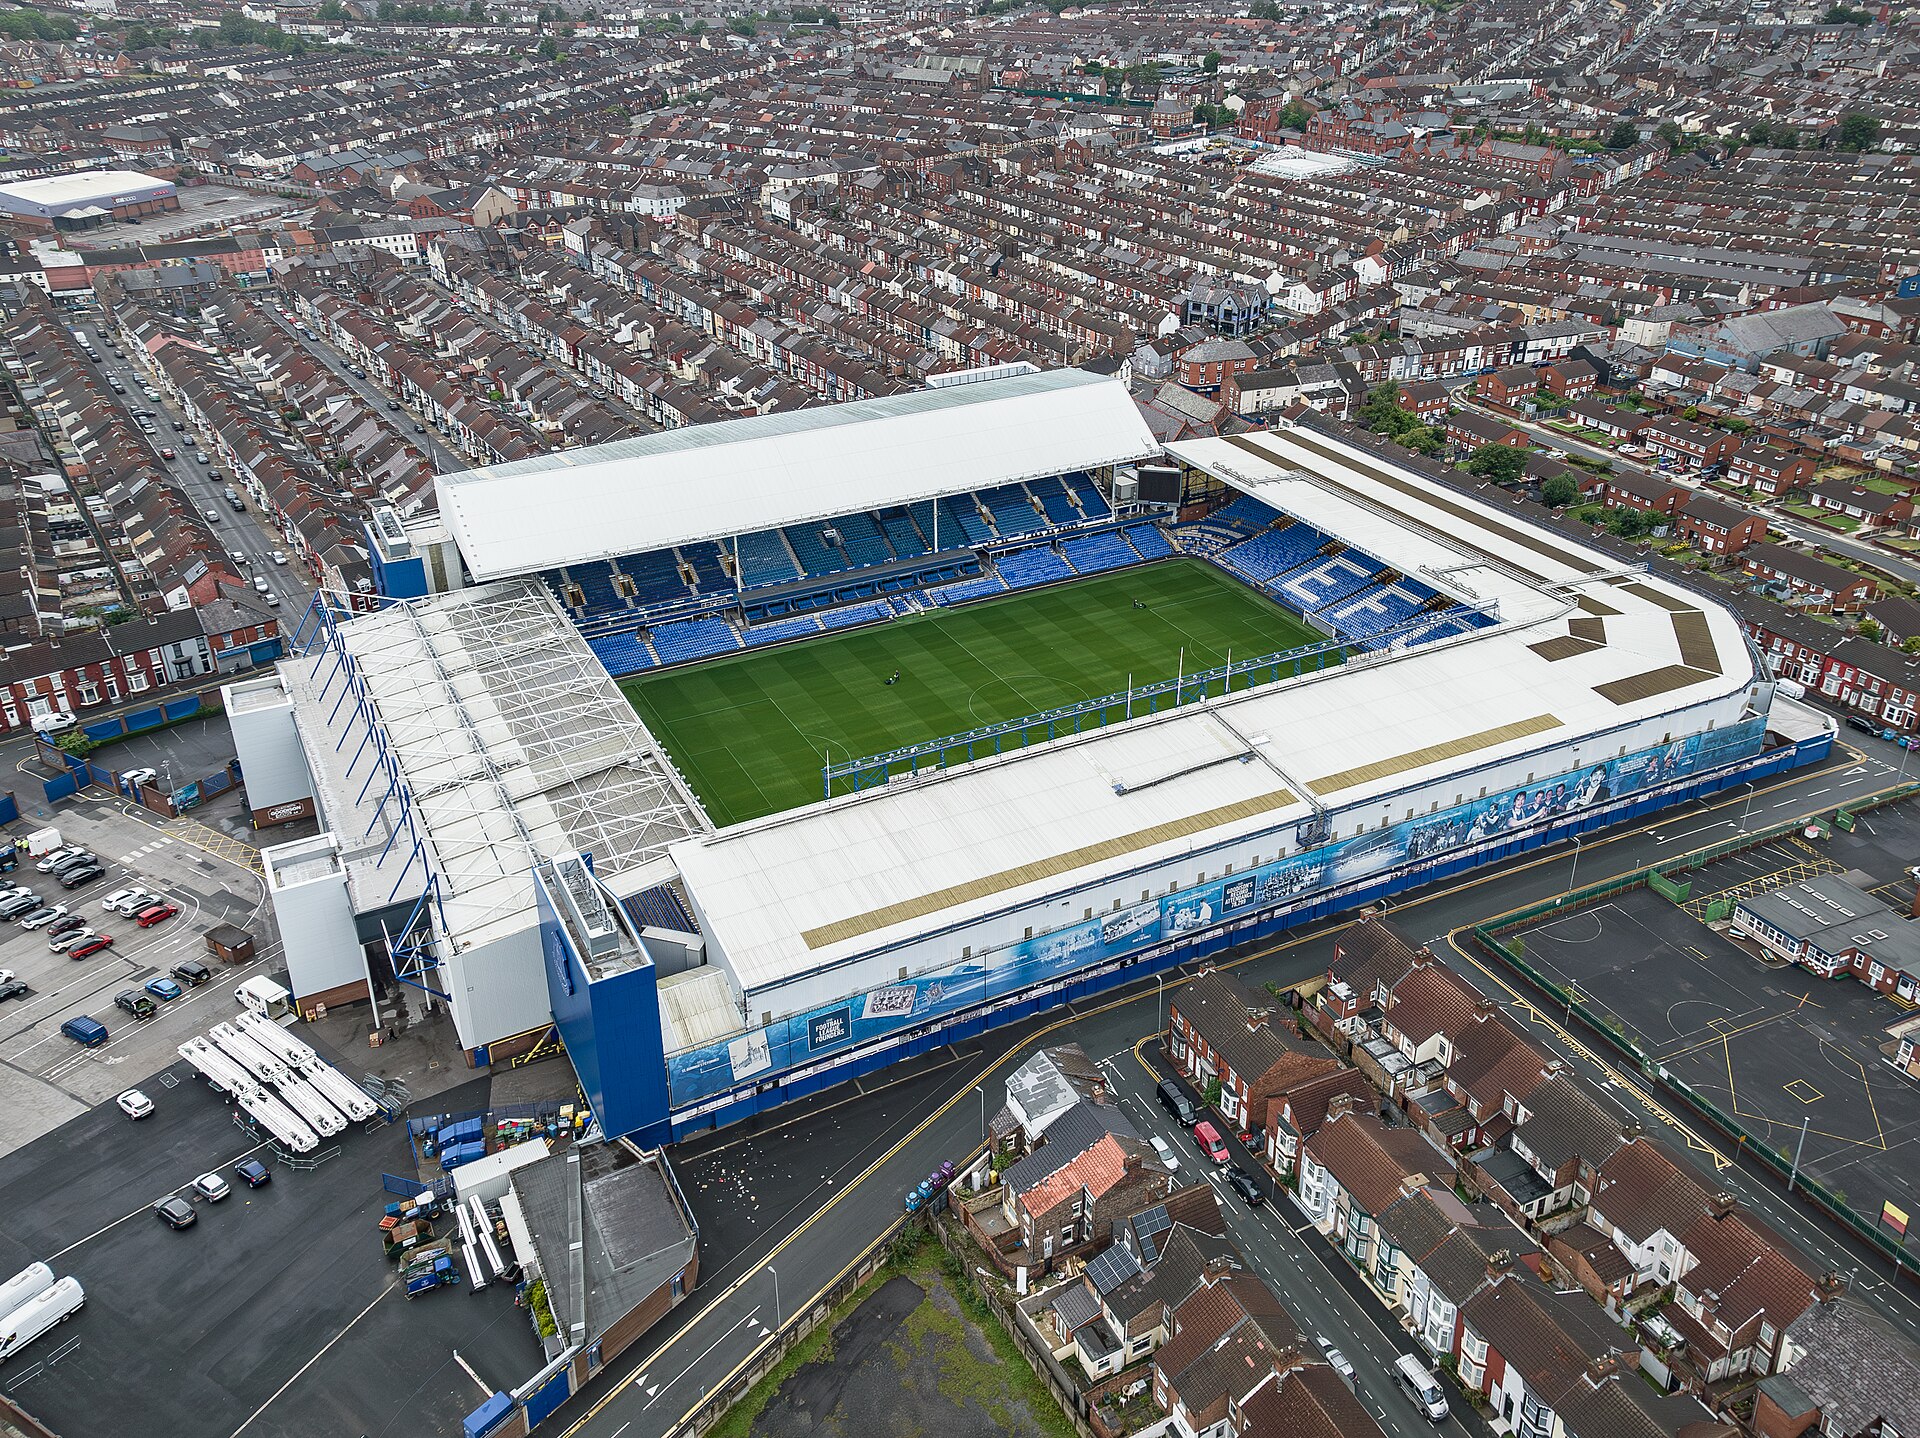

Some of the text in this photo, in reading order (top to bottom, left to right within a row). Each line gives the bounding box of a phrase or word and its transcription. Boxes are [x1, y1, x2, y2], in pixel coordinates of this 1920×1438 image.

[816, 1018, 843, 1032] FOOTBALL
[819, 1023, 840, 1036] LEAGUE
[815, 1028, 845, 1043] FOUNDERS
[1556, 1033, 1590, 1061] SCHOOL
[1641, 1100, 1673, 1126] CLEAR
